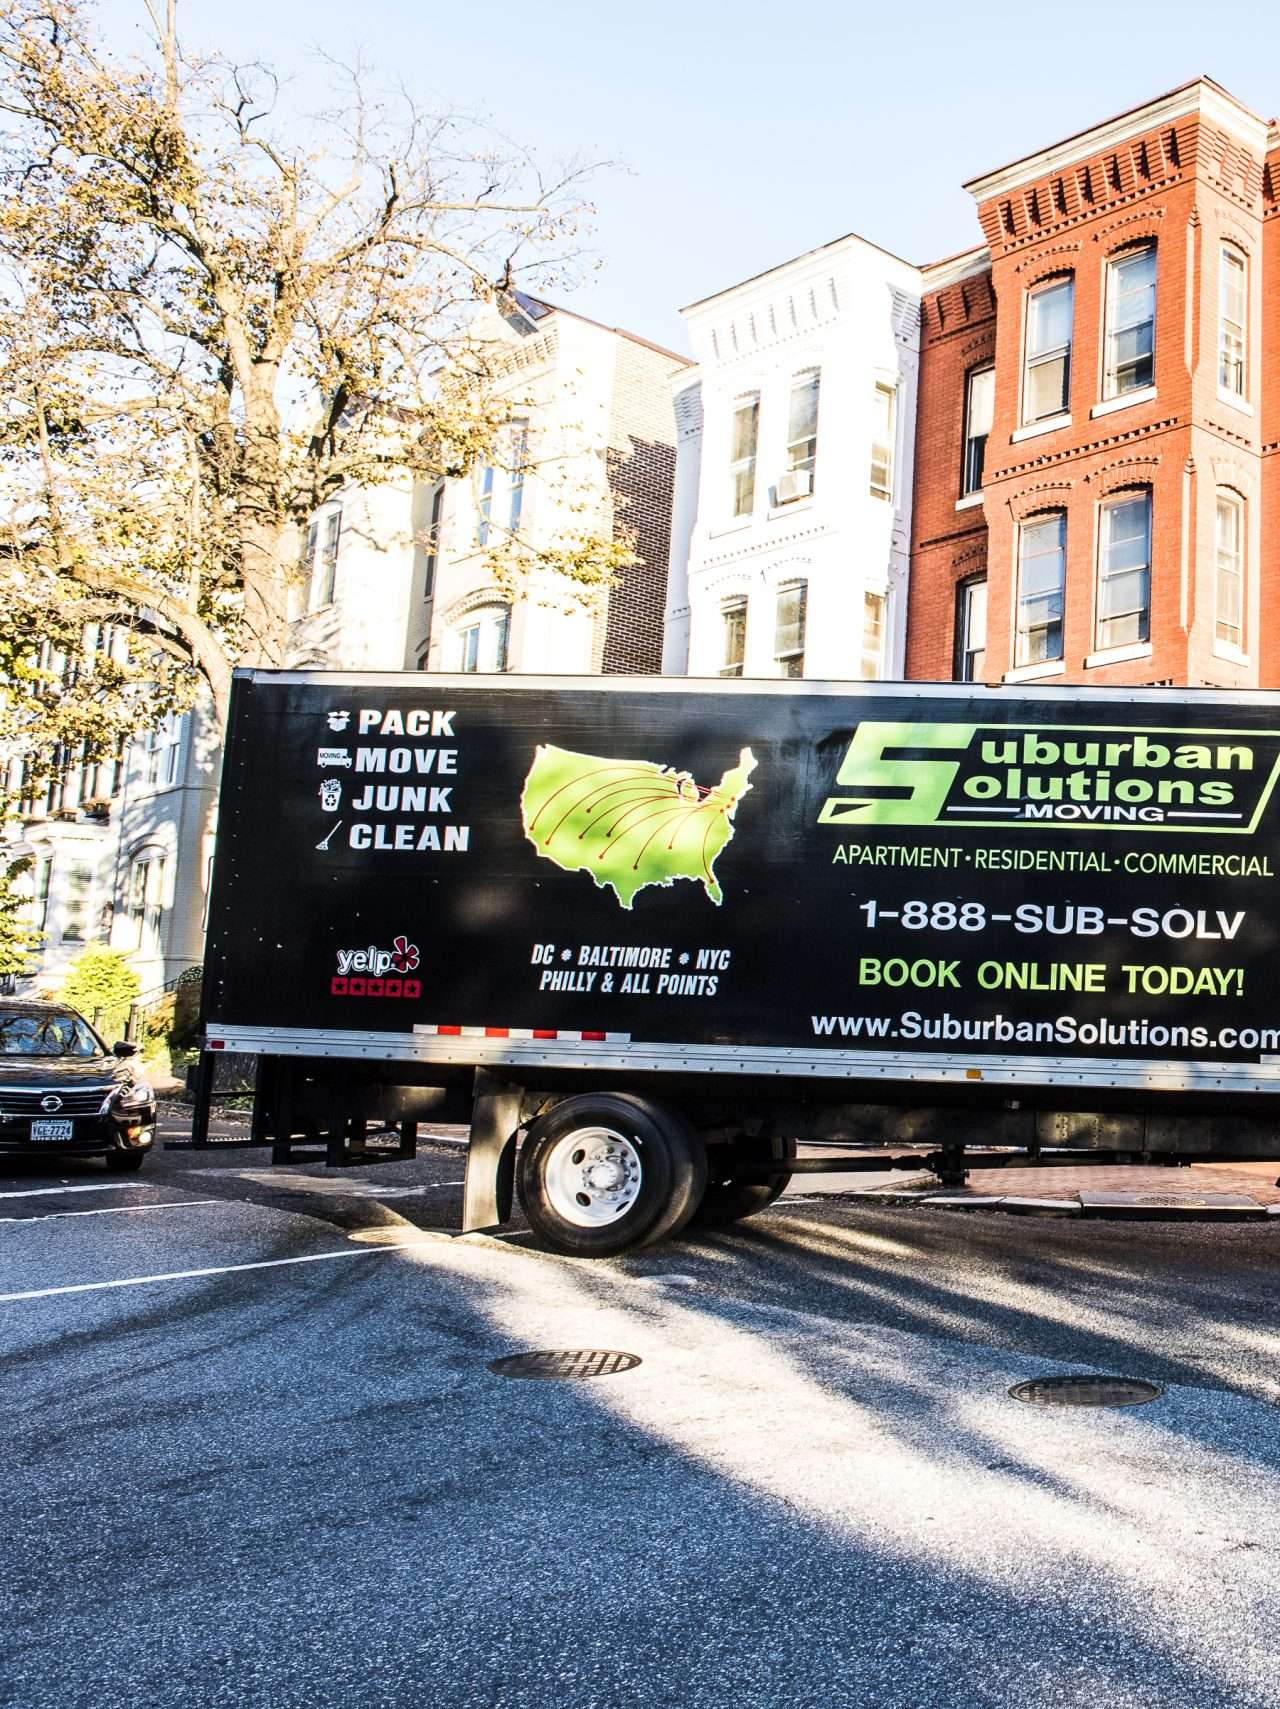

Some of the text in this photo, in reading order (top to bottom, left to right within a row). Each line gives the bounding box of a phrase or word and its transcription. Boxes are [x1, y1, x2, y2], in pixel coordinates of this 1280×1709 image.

[358, 709, 457, 736] PACK
[355, 748, 458, 774] MOVE
[352, 785, 453, 812] JUNK
[1025, 804, 1165, 822] MOVING
[349, 824, 470, 851] CLEAN
[859, 900, 1247, 940] 1-888-SUB-SOLV
[337, 946, 392, 976] yelp
[531, 944, 732, 970] DC BALTIMORE NYC
[539, 970, 719, 996] PHILLY & ALL POINTS
[858, 958, 1245, 997] BOOK ONLINE TODAY!
